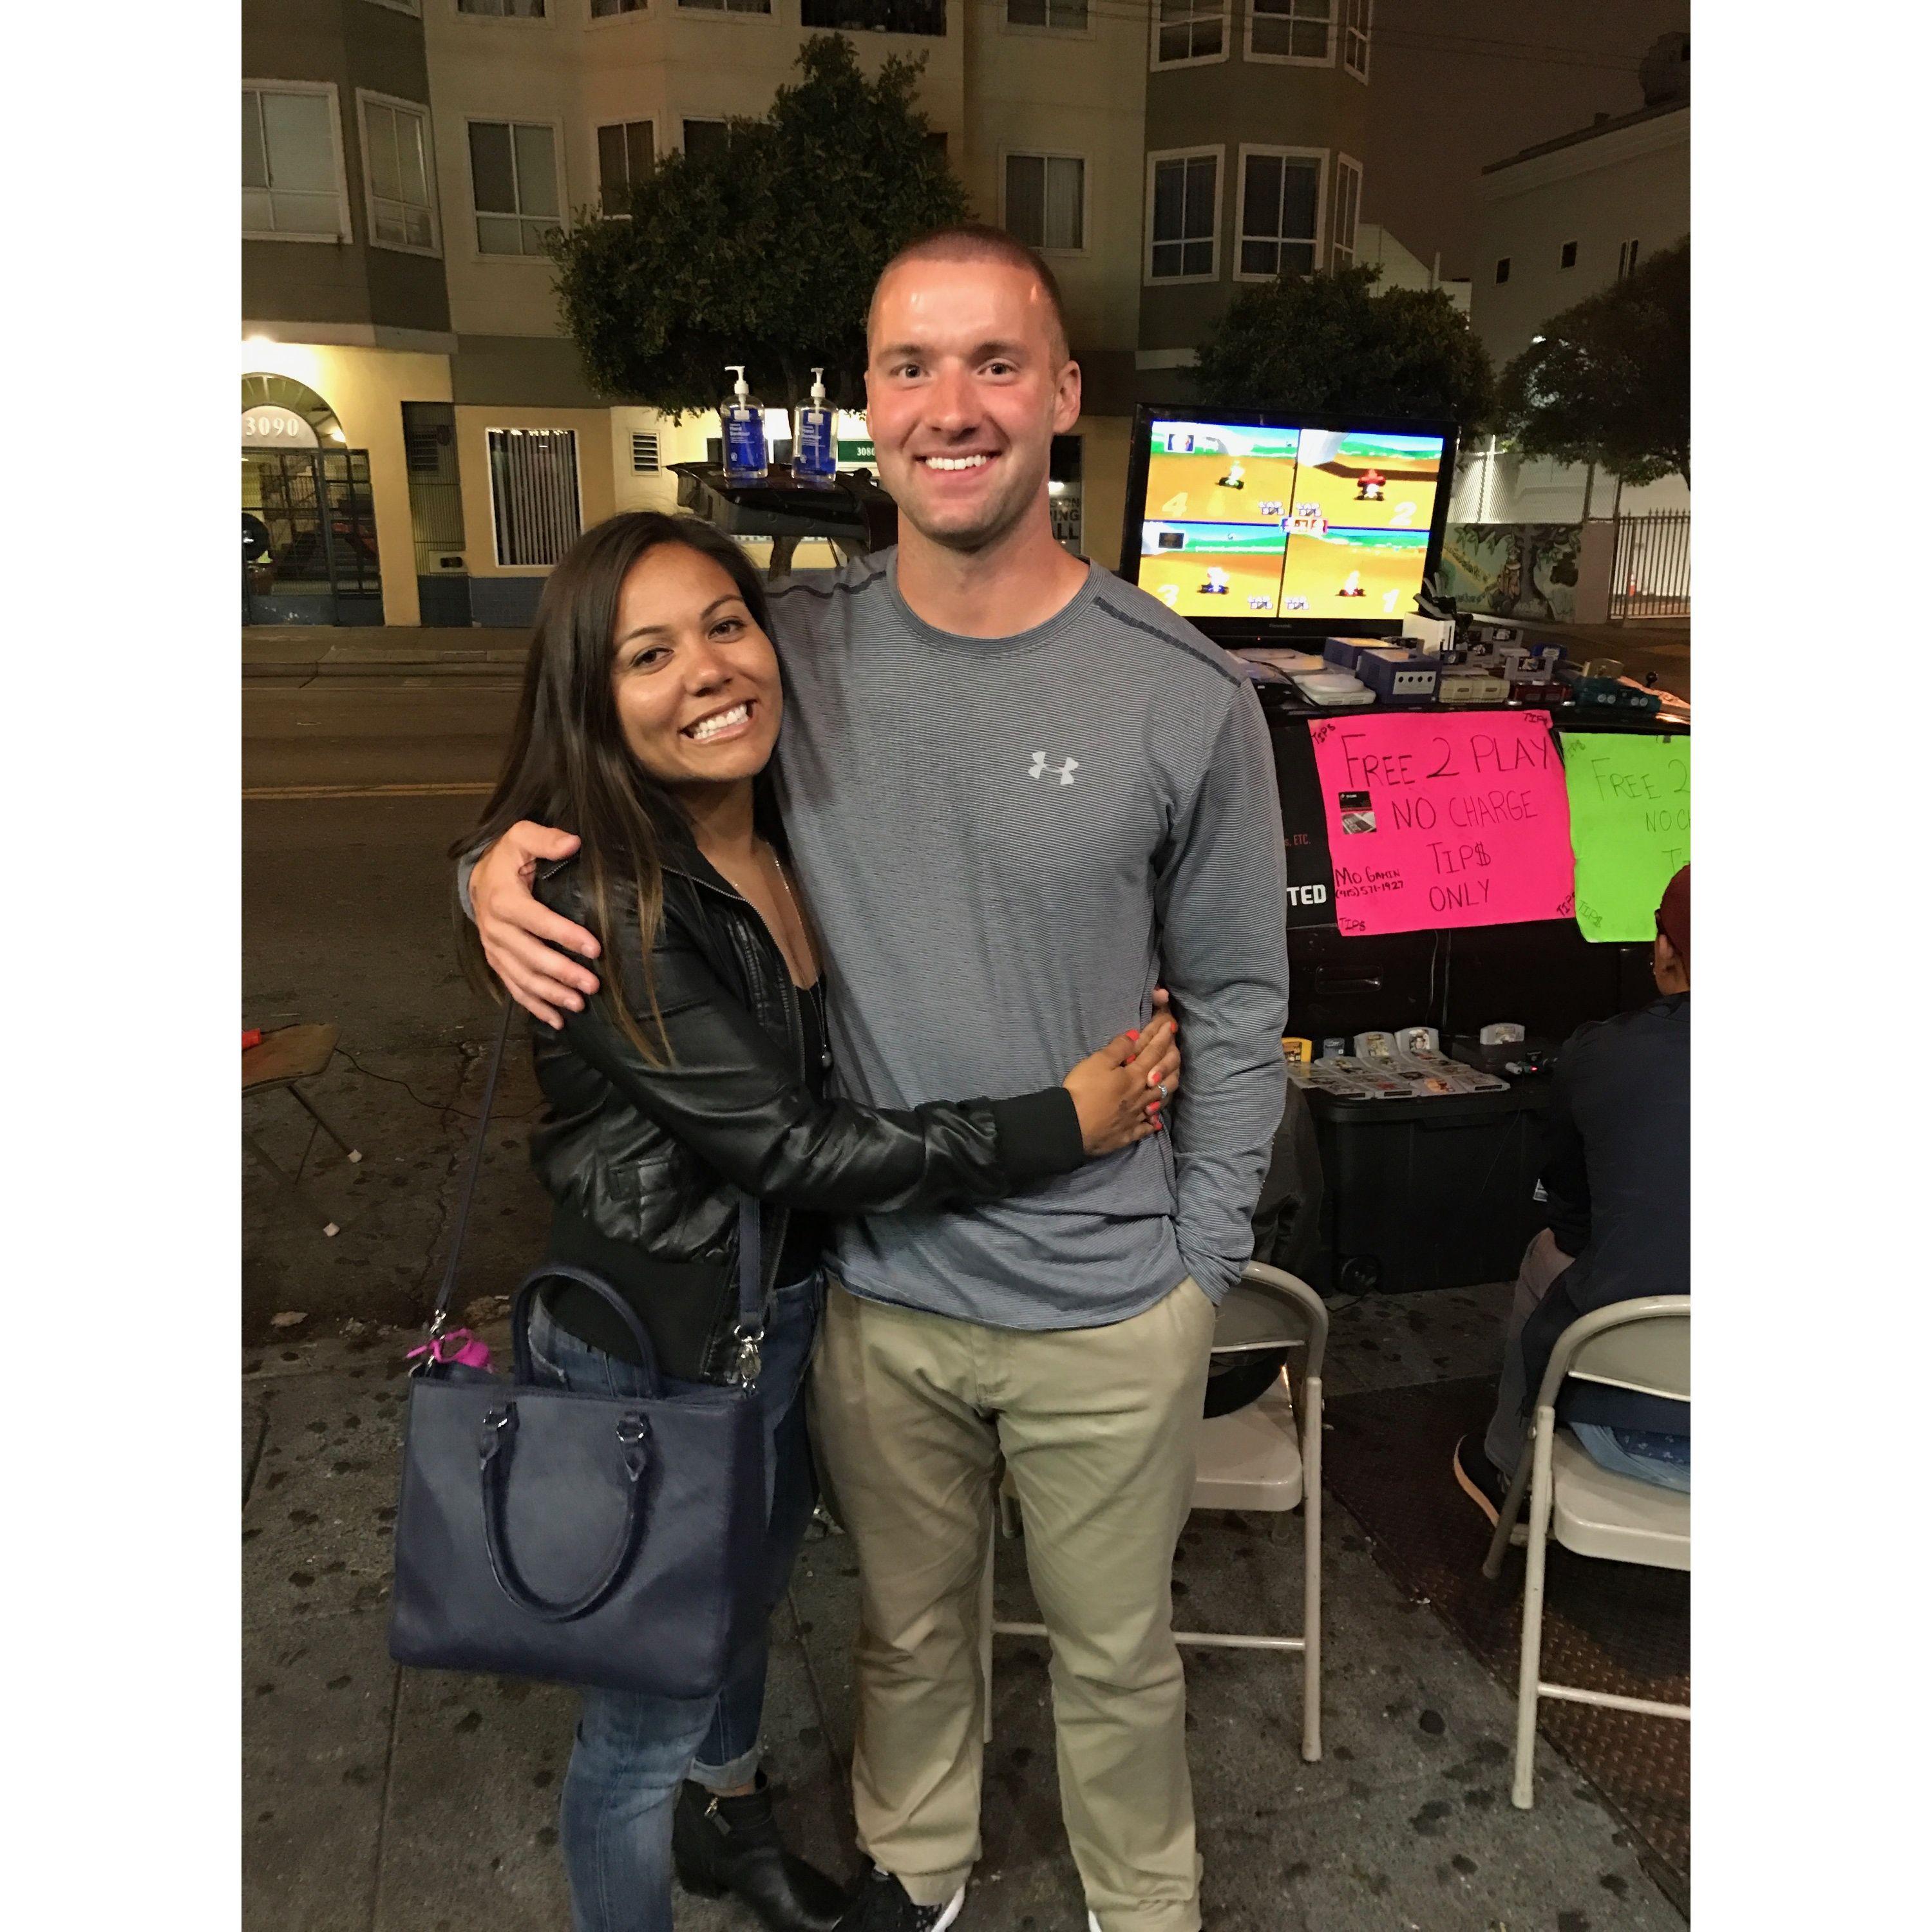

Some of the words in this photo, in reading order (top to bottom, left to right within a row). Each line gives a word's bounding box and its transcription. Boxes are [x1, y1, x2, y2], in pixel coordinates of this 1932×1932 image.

[246, 417, 299, 437] 3090
[1162, 492, 1188, 517] 4
[1389, 501, 1417, 527] 2
[1157, 585, 1179, 607] 3
[1381, 589, 1400, 612] 1
[1341, 734, 1416, 788] FREE
[1426, 737, 1460, 779] 2
[1470, 734, 1548, 773] PLAY
[1591, 757, 1662, 801] FREE
[1668, 759, 1690, 793] 2
[1390, 797, 1437, 830] NO
[1448, 790, 1539, 828] CHARGE
[1645, 810, 1672, 833] NO
[1426, 840, 1492, 875] TIP$
[1429, 878, 1490, 912] ONLY
